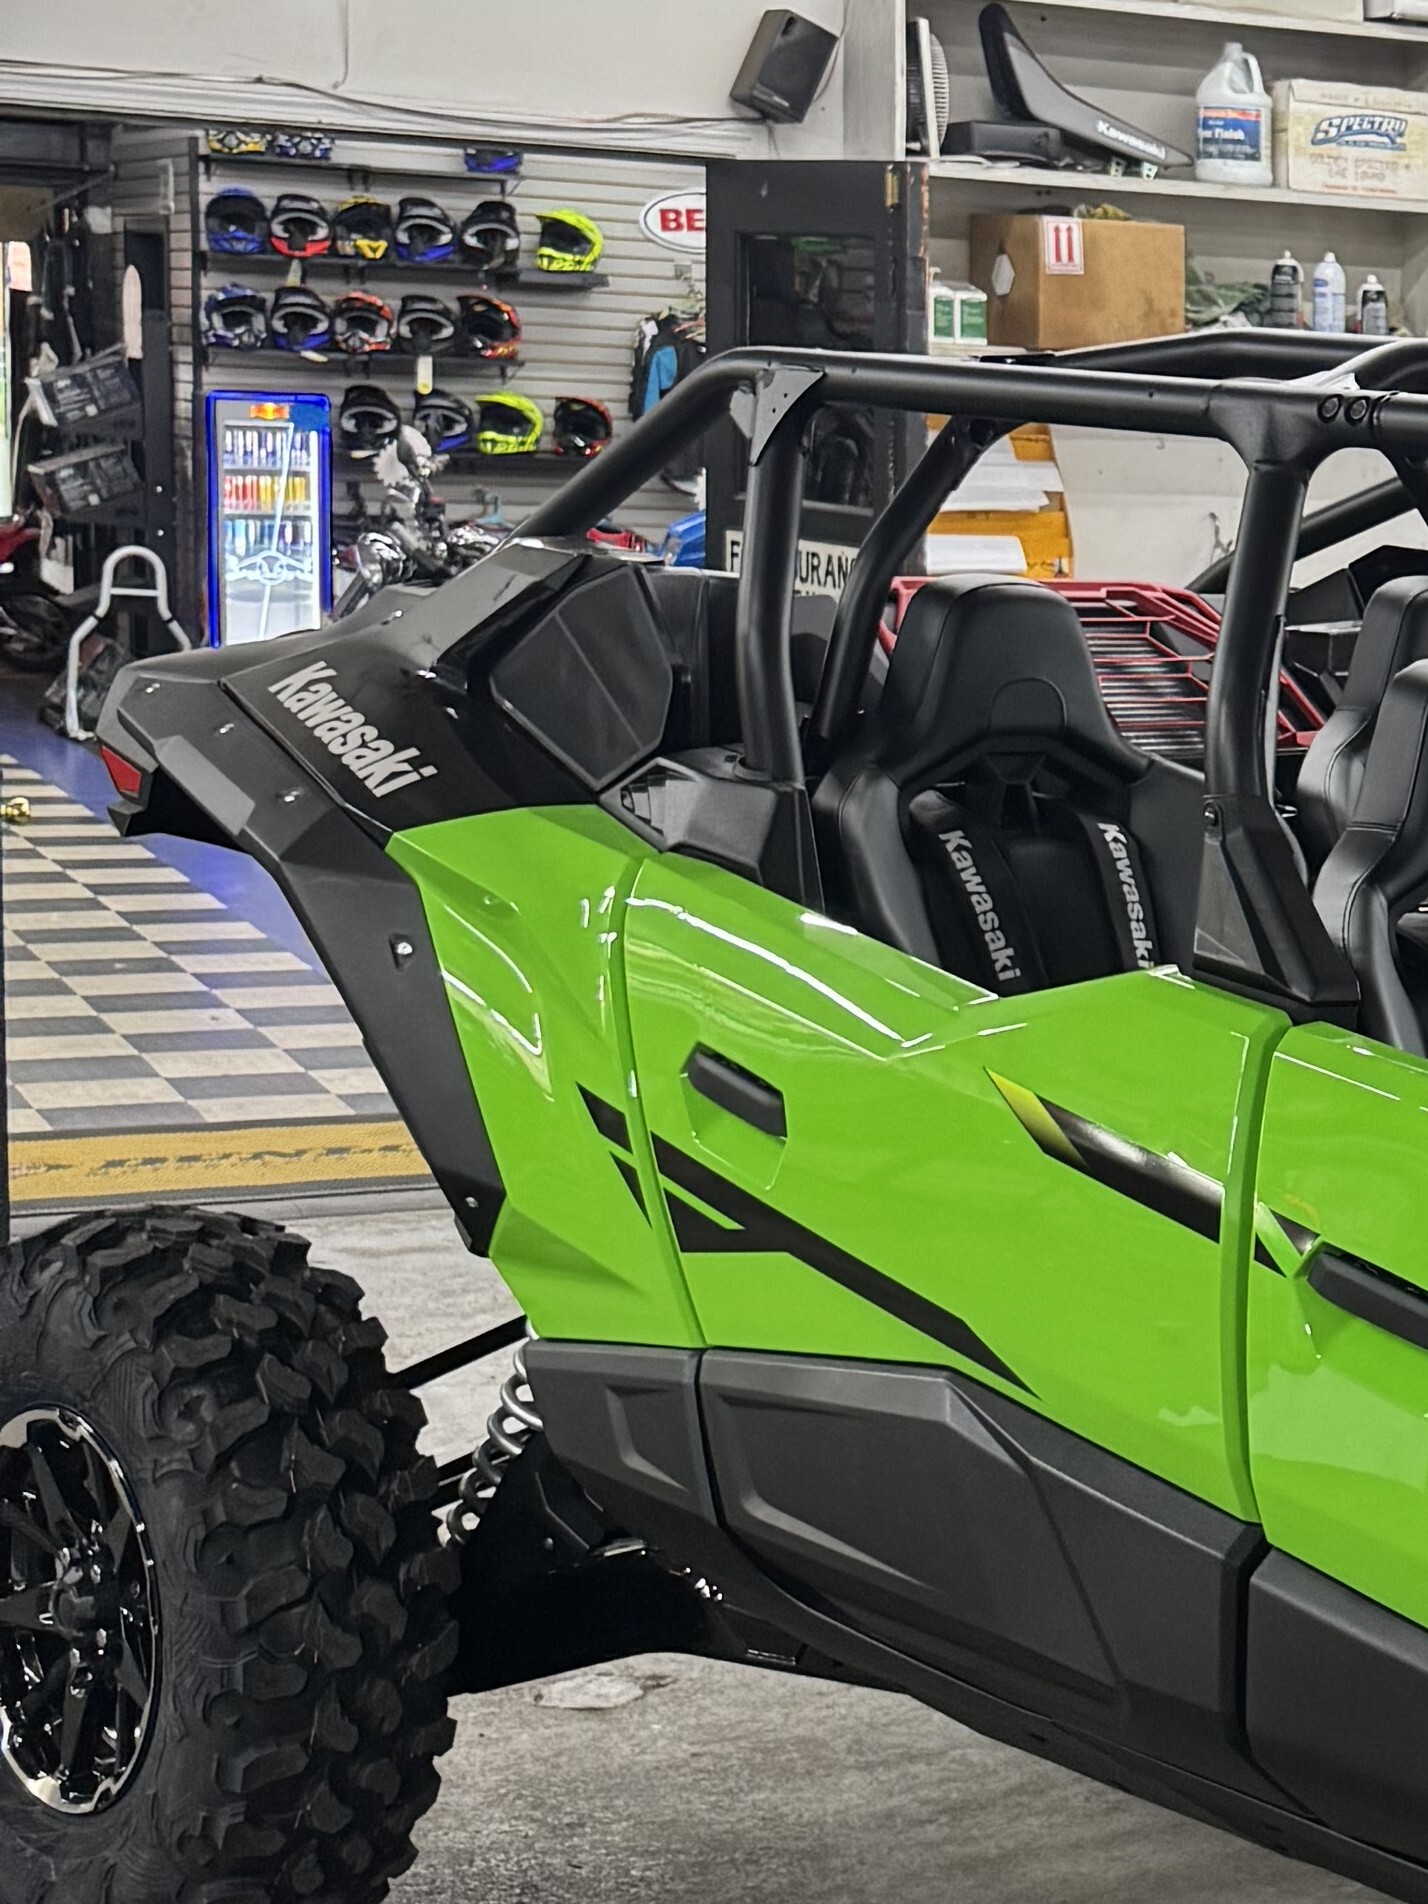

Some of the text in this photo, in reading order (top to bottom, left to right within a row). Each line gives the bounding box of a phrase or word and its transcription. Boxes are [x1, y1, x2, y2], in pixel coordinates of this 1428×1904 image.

[267, 660, 438, 798] Kawasaki
[939, 827, 1023, 983] Kawasaki
[1098, 821, 1155, 971] Kawasaki
